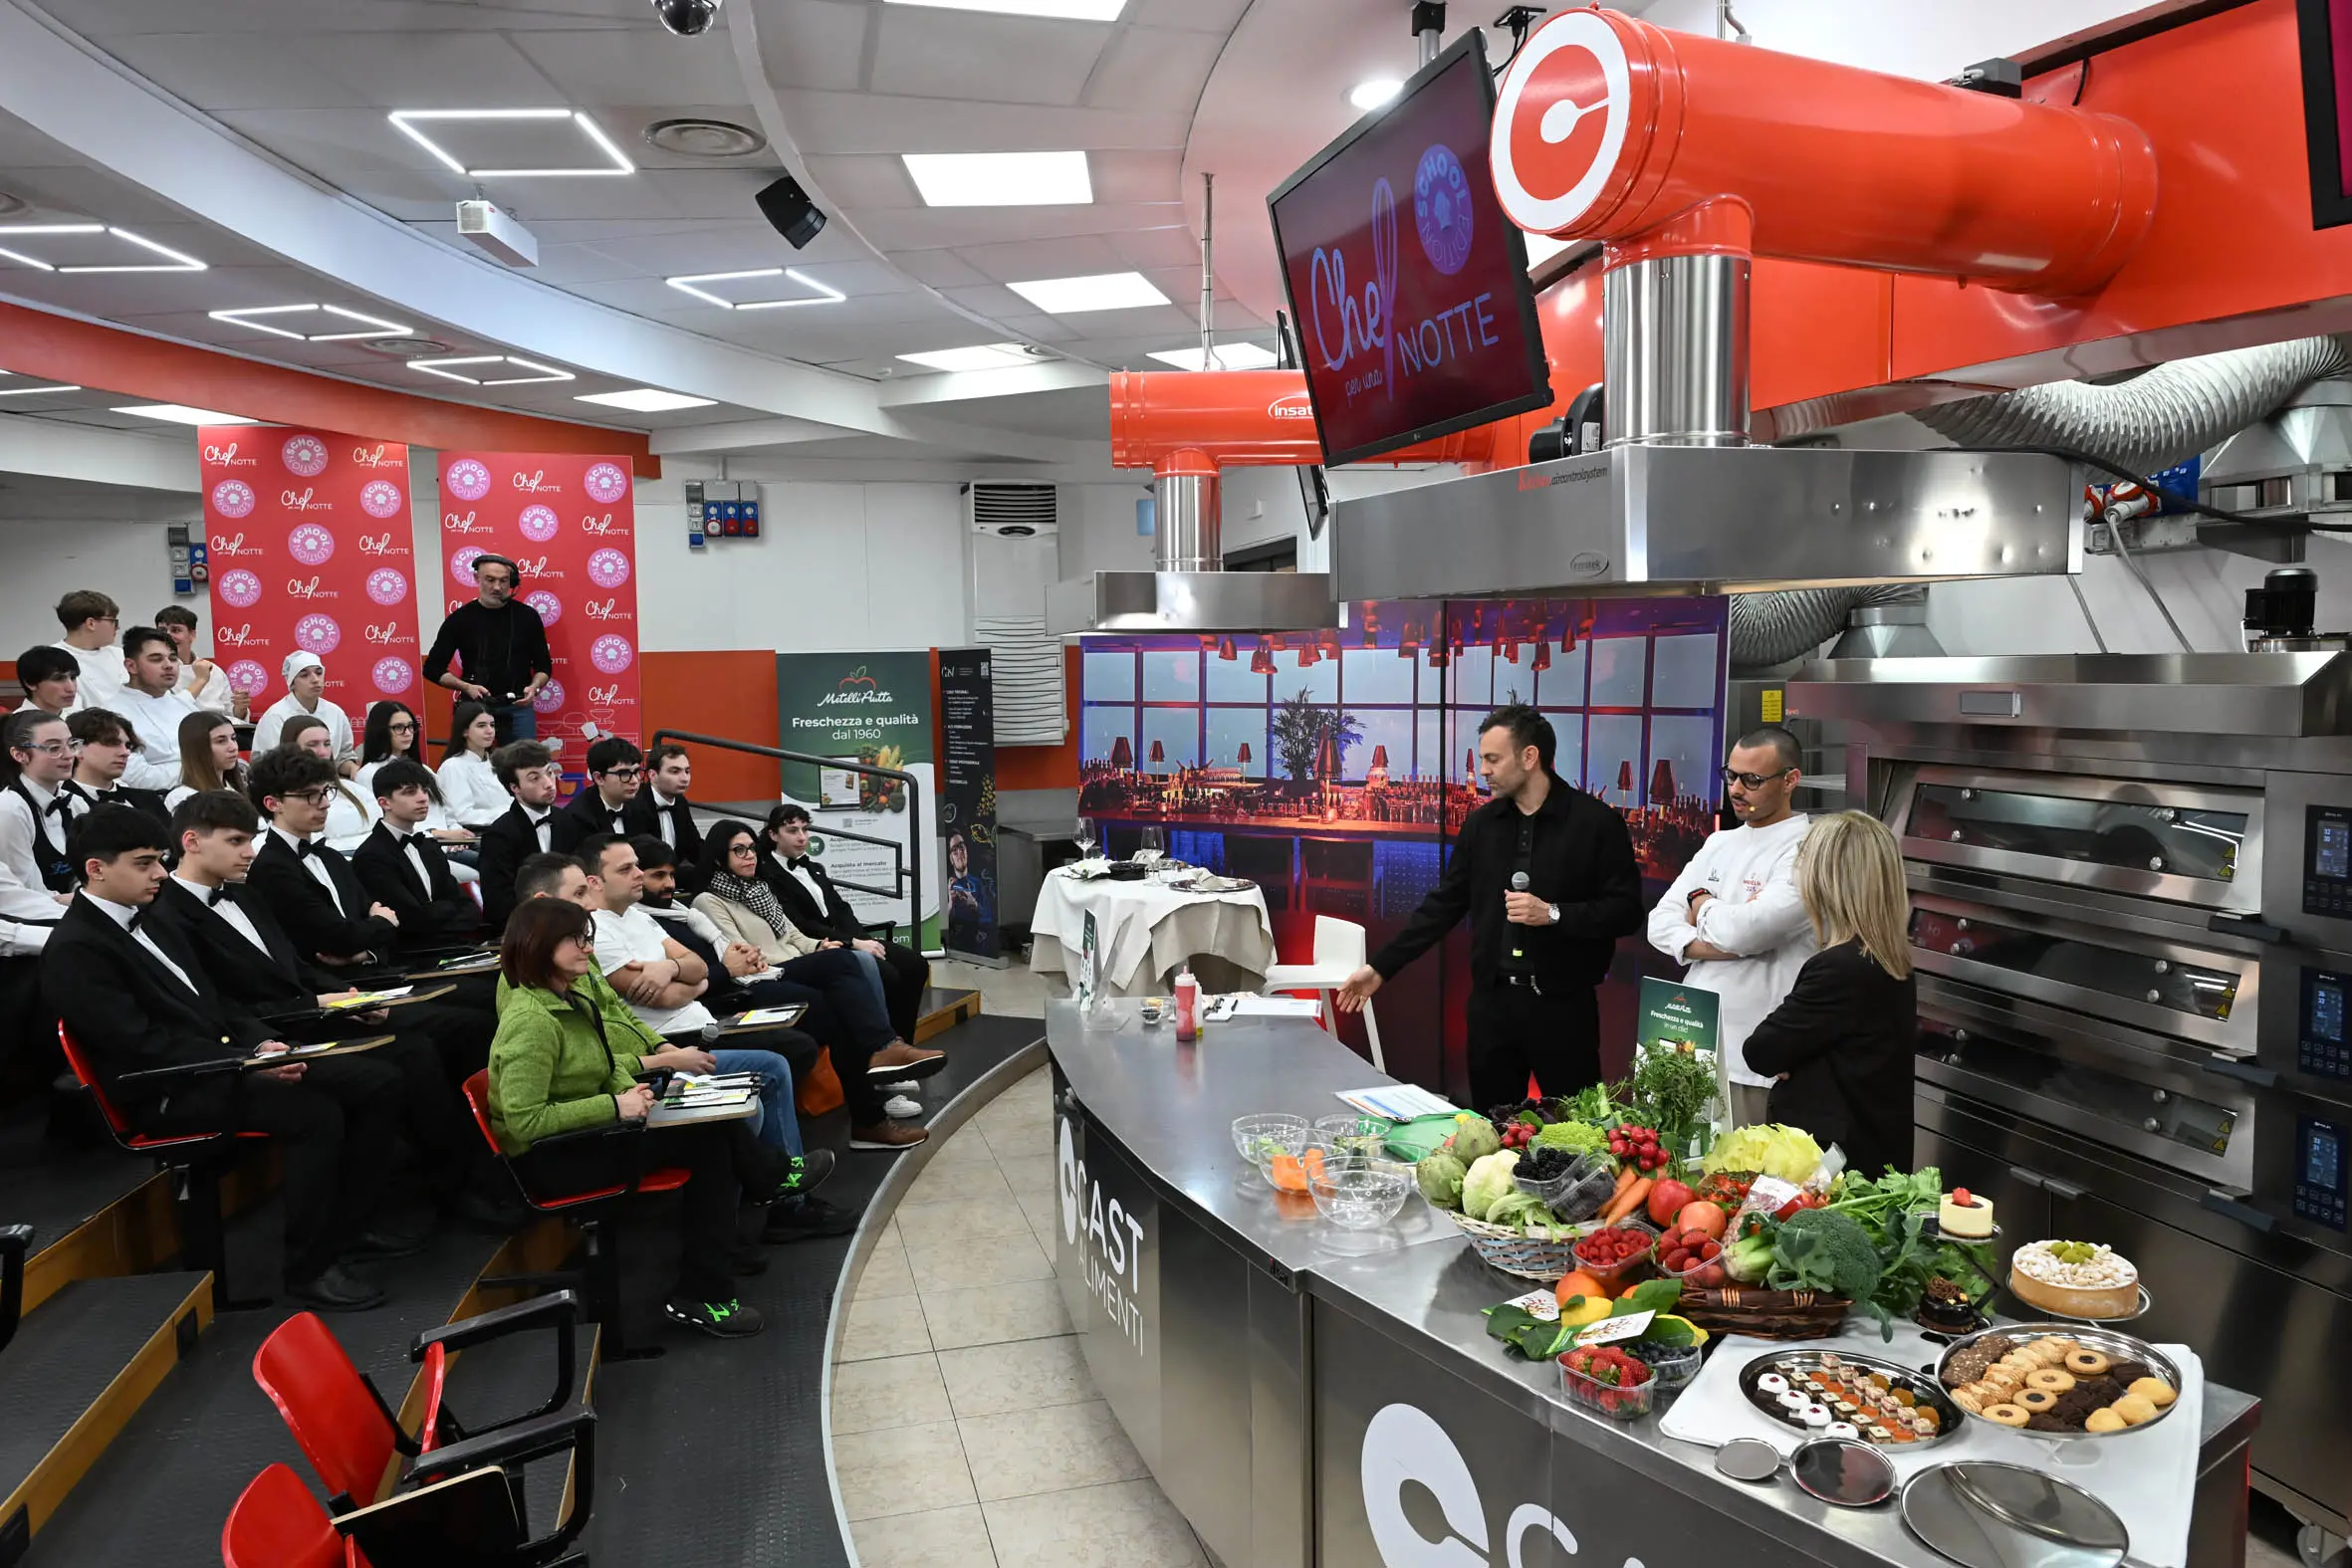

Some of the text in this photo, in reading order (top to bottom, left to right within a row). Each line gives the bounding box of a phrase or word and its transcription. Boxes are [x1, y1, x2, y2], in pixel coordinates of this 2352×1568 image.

[1418, 153, 1466, 217] SCHOOL
[1421, 215, 1470, 267] EDITION
[1310, 177, 1398, 401] Chef
[1345, 292, 1500, 408] per una NOTTE
[205, 443, 237, 466] Chef
[287, 438, 324, 458] SCHOOL
[353, 445, 384, 468] Chef
[452, 462, 486, 482] SCHOOL
[514, 470, 544, 493] Chef
[588, 466, 623, 485] SCHOOL
[217, 483, 251, 500] SCHOOL
[281, 488, 313, 511] Chef
[364, 484, 397, 501] SCHOOL
[445, 512, 476, 534] Chef
[524, 509, 555, 526] SCHOOL
[583, 514, 611, 537] Chef
[211, 534, 243, 556] Chef
[293, 528, 331, 547] SCHOOL
[359, 534, 390, 556] Chef
[518, 556, 547, 579] Chef
[591, 552, 625, 569] SCHOOL
[223, 573, 257, 589] SCHOOL
[287, 575, 319, 599] Chef
[370, 571, 403, 588] SCHOOL
[586, 598, 615, 621] Chef
[217, 623, 251, 647] Chef
[300, 617, 337, 636] SCHOOL
[364, 621, 396, 645] Chef
[595, 637, 629, 656] SCHOOL
[230, 663, 264, 679] SCHOOL
[376, 660, 409, 677] SCHOOL
[589, 684, 617, 707] Chef
[793, 717, 862, 727] Freschezza
[876, 714, 918, 727] qualità
[832, 729, 880, 740] dal 1960
[1651, 1009, 1679, 1023] Freschezza
[1076, 1160, 1143, 1294] CAST
[1077, 1235, 1143, 1357] ALIMENTI
